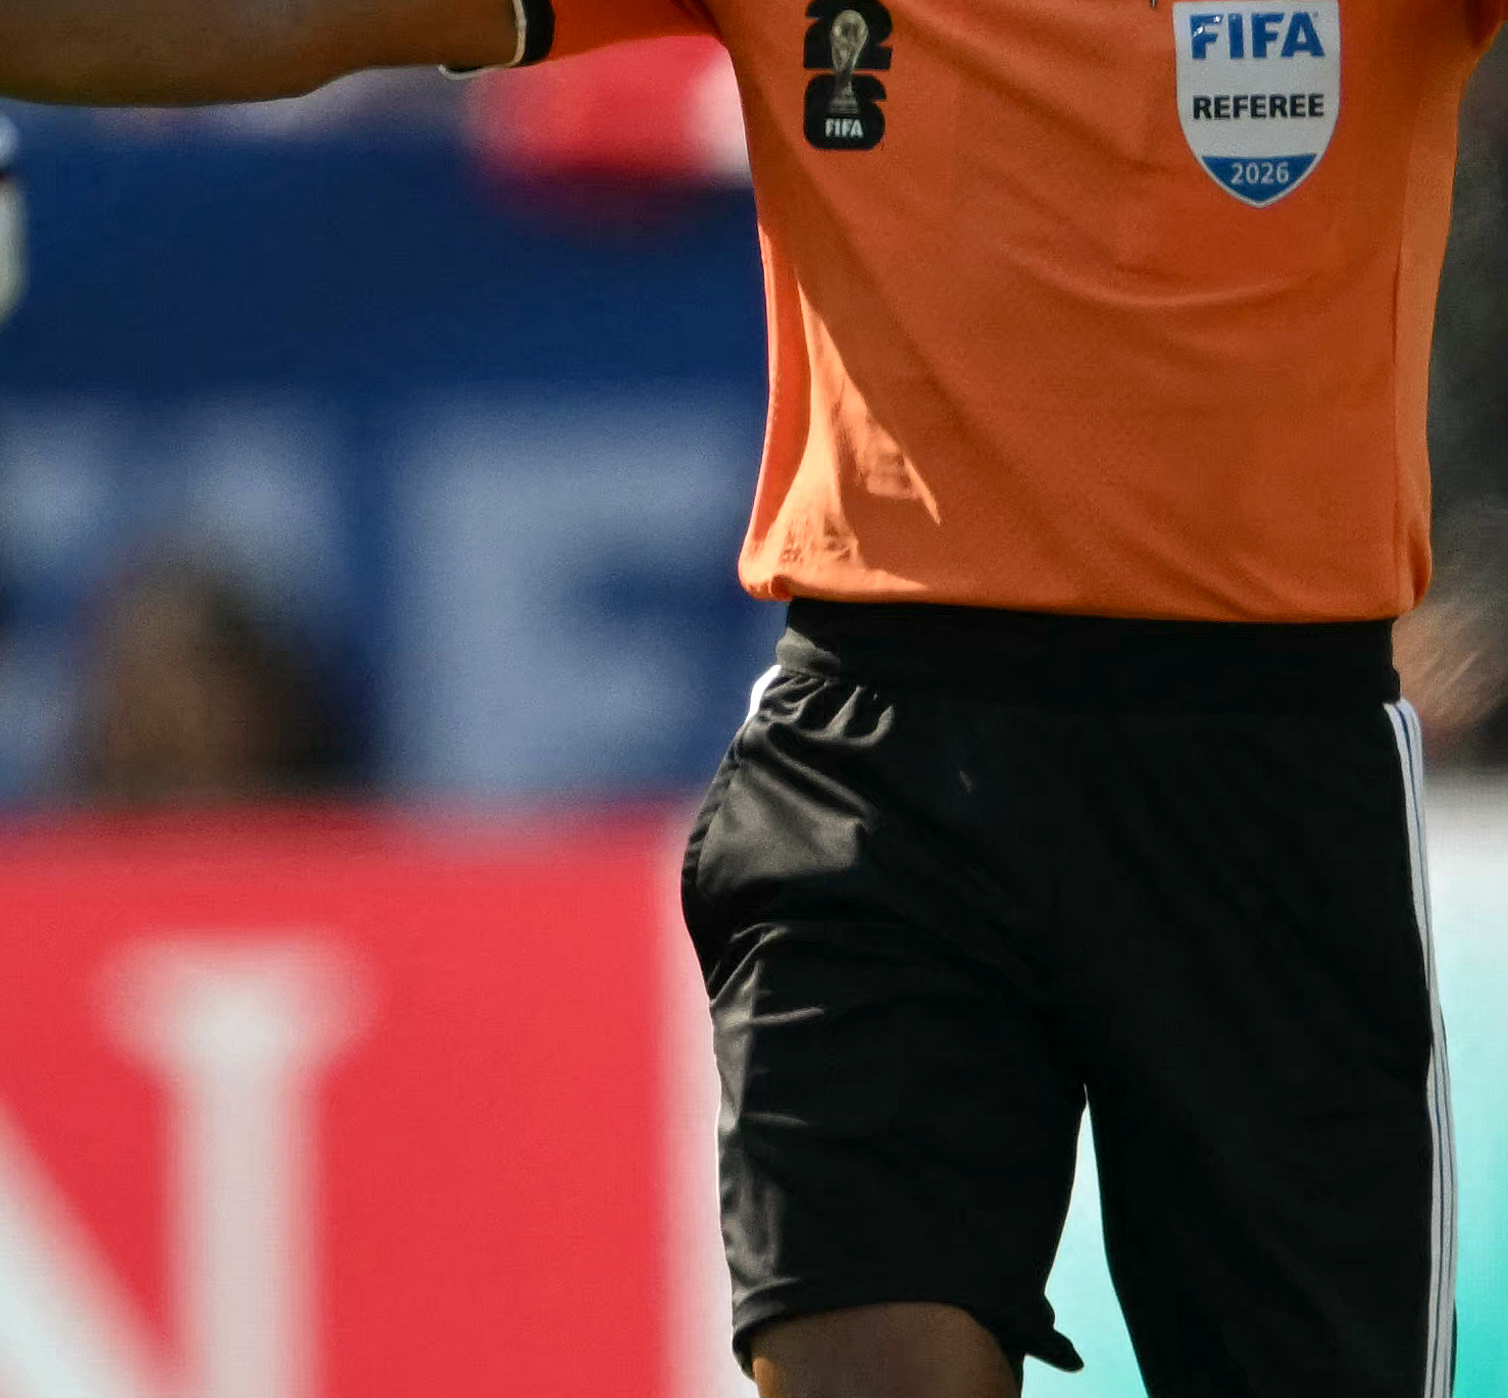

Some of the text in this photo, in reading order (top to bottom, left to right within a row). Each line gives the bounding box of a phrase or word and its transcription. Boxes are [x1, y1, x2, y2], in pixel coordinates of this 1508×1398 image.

[1189, 11, 1325, 60] FIFA
[1192, 93, 1325, 121] REFEREE
[824, 117, 864, 139] FIFA
[1230, 161, 1290, 186] 2026
